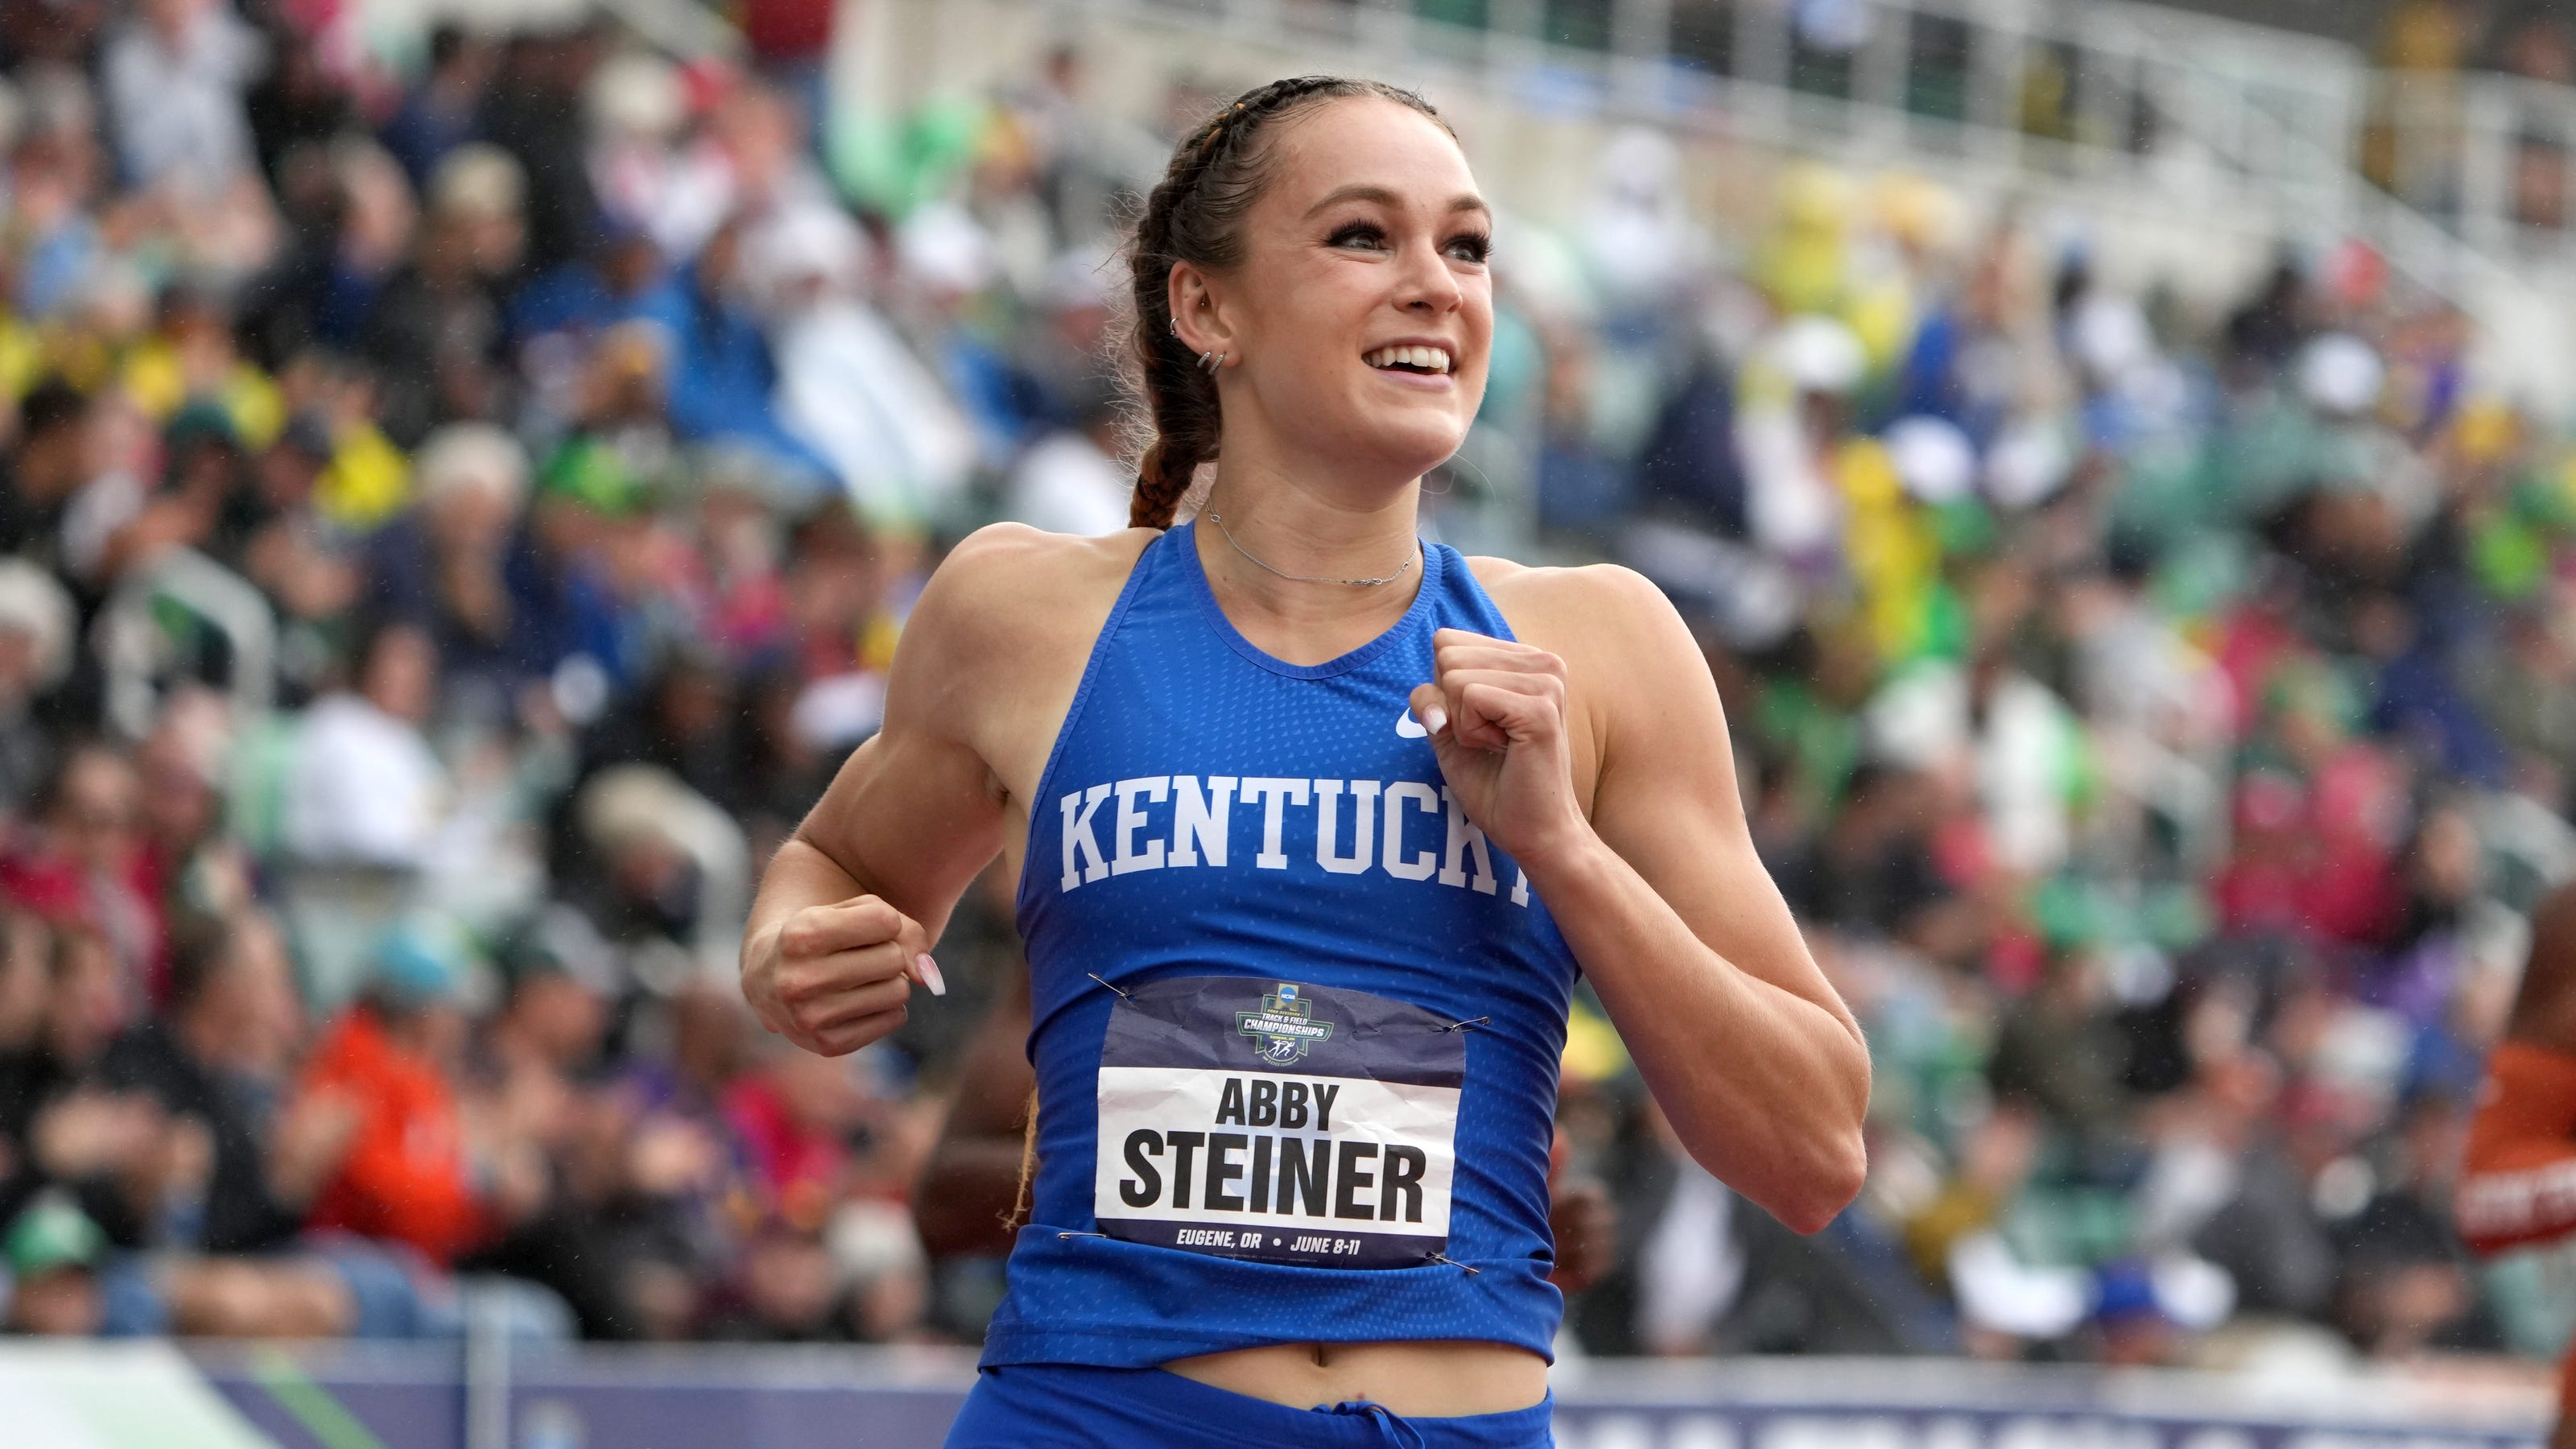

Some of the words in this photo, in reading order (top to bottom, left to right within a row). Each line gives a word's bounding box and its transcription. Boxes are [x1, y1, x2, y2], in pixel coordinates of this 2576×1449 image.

[1060, 775, 1529, 907] KENTUCK
[1244, 1018, 1324, 1037] CHAMPIONSHIPS
[1262, 1013, 1283, 1022] TRACK
[1290, 1017, 1308, 1026] FIELD
[1216, 1078, 1340, 1131] ABBY
[1119, 1129, 1426, 1223] STEINER
[1176, 1228, 1236, 1249] EUGENE,
[1240, 1232, 1262, 1249] OR
[1290, 1236, 1331, 1253] JUNE
[1333, 1239, 1360, 1255] 8-11
